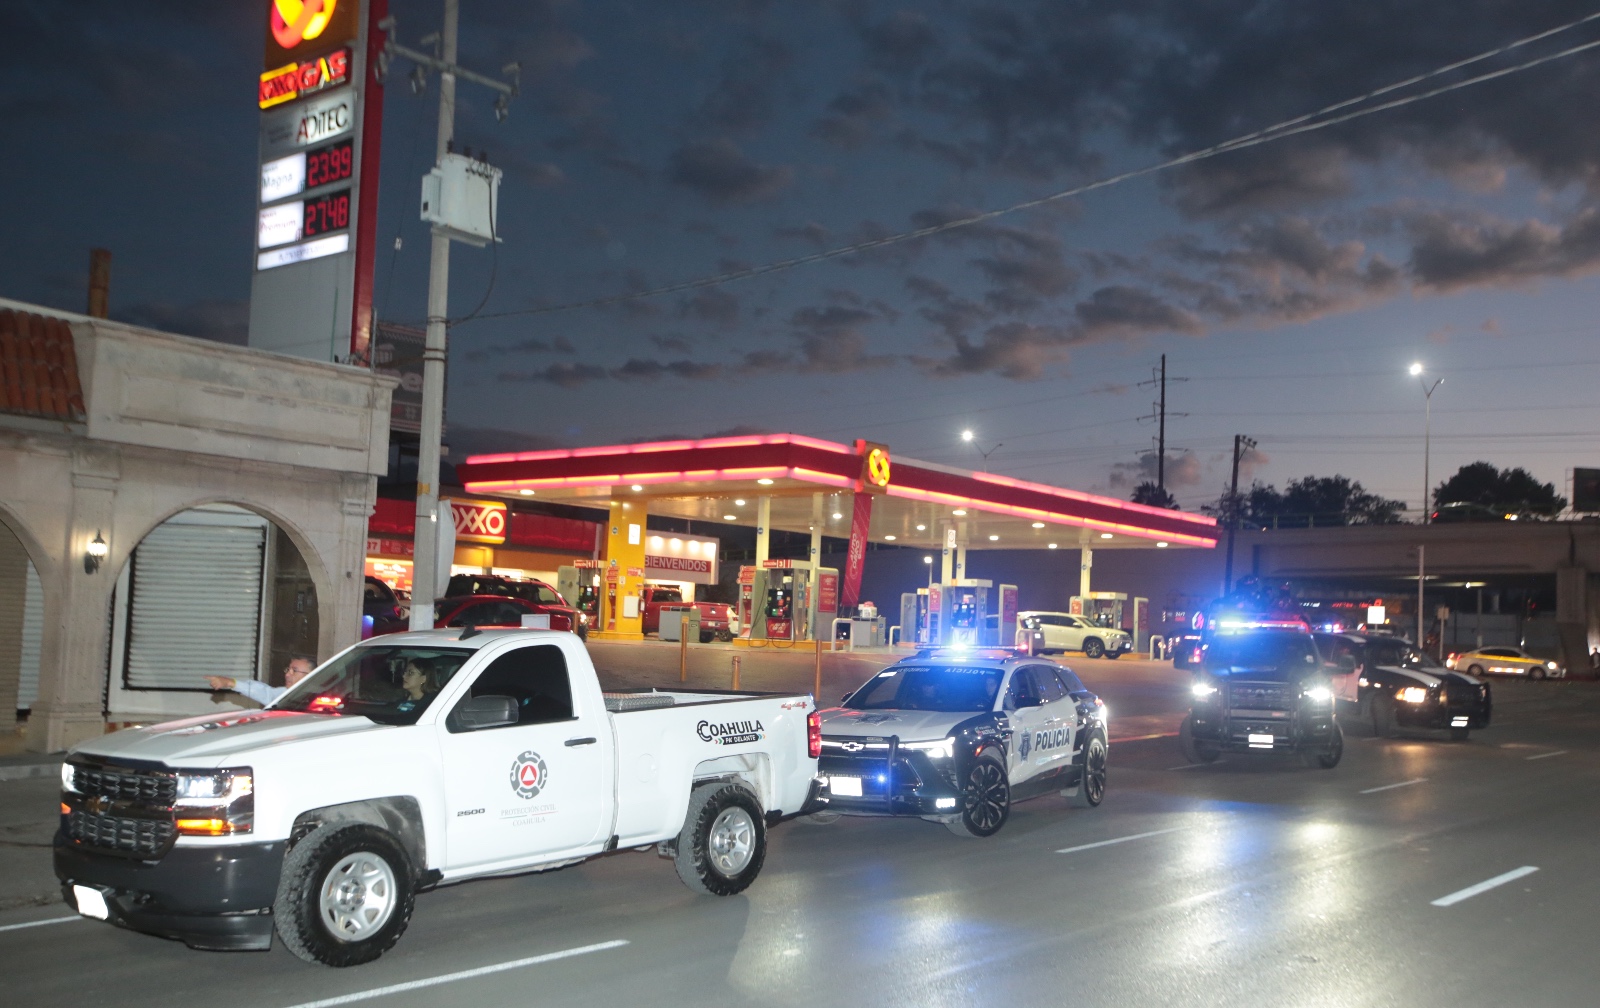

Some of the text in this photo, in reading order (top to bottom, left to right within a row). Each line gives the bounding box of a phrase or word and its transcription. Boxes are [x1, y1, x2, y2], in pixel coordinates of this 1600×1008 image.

[697, 720, 764, 742] COAHUILA
[735, 735, 756, 743] DELANTE
[540, 803, 556, 812] CIVIL
[457, 808, 485, 817] 2500
[512, 816, 546, 827] COAHUILA
